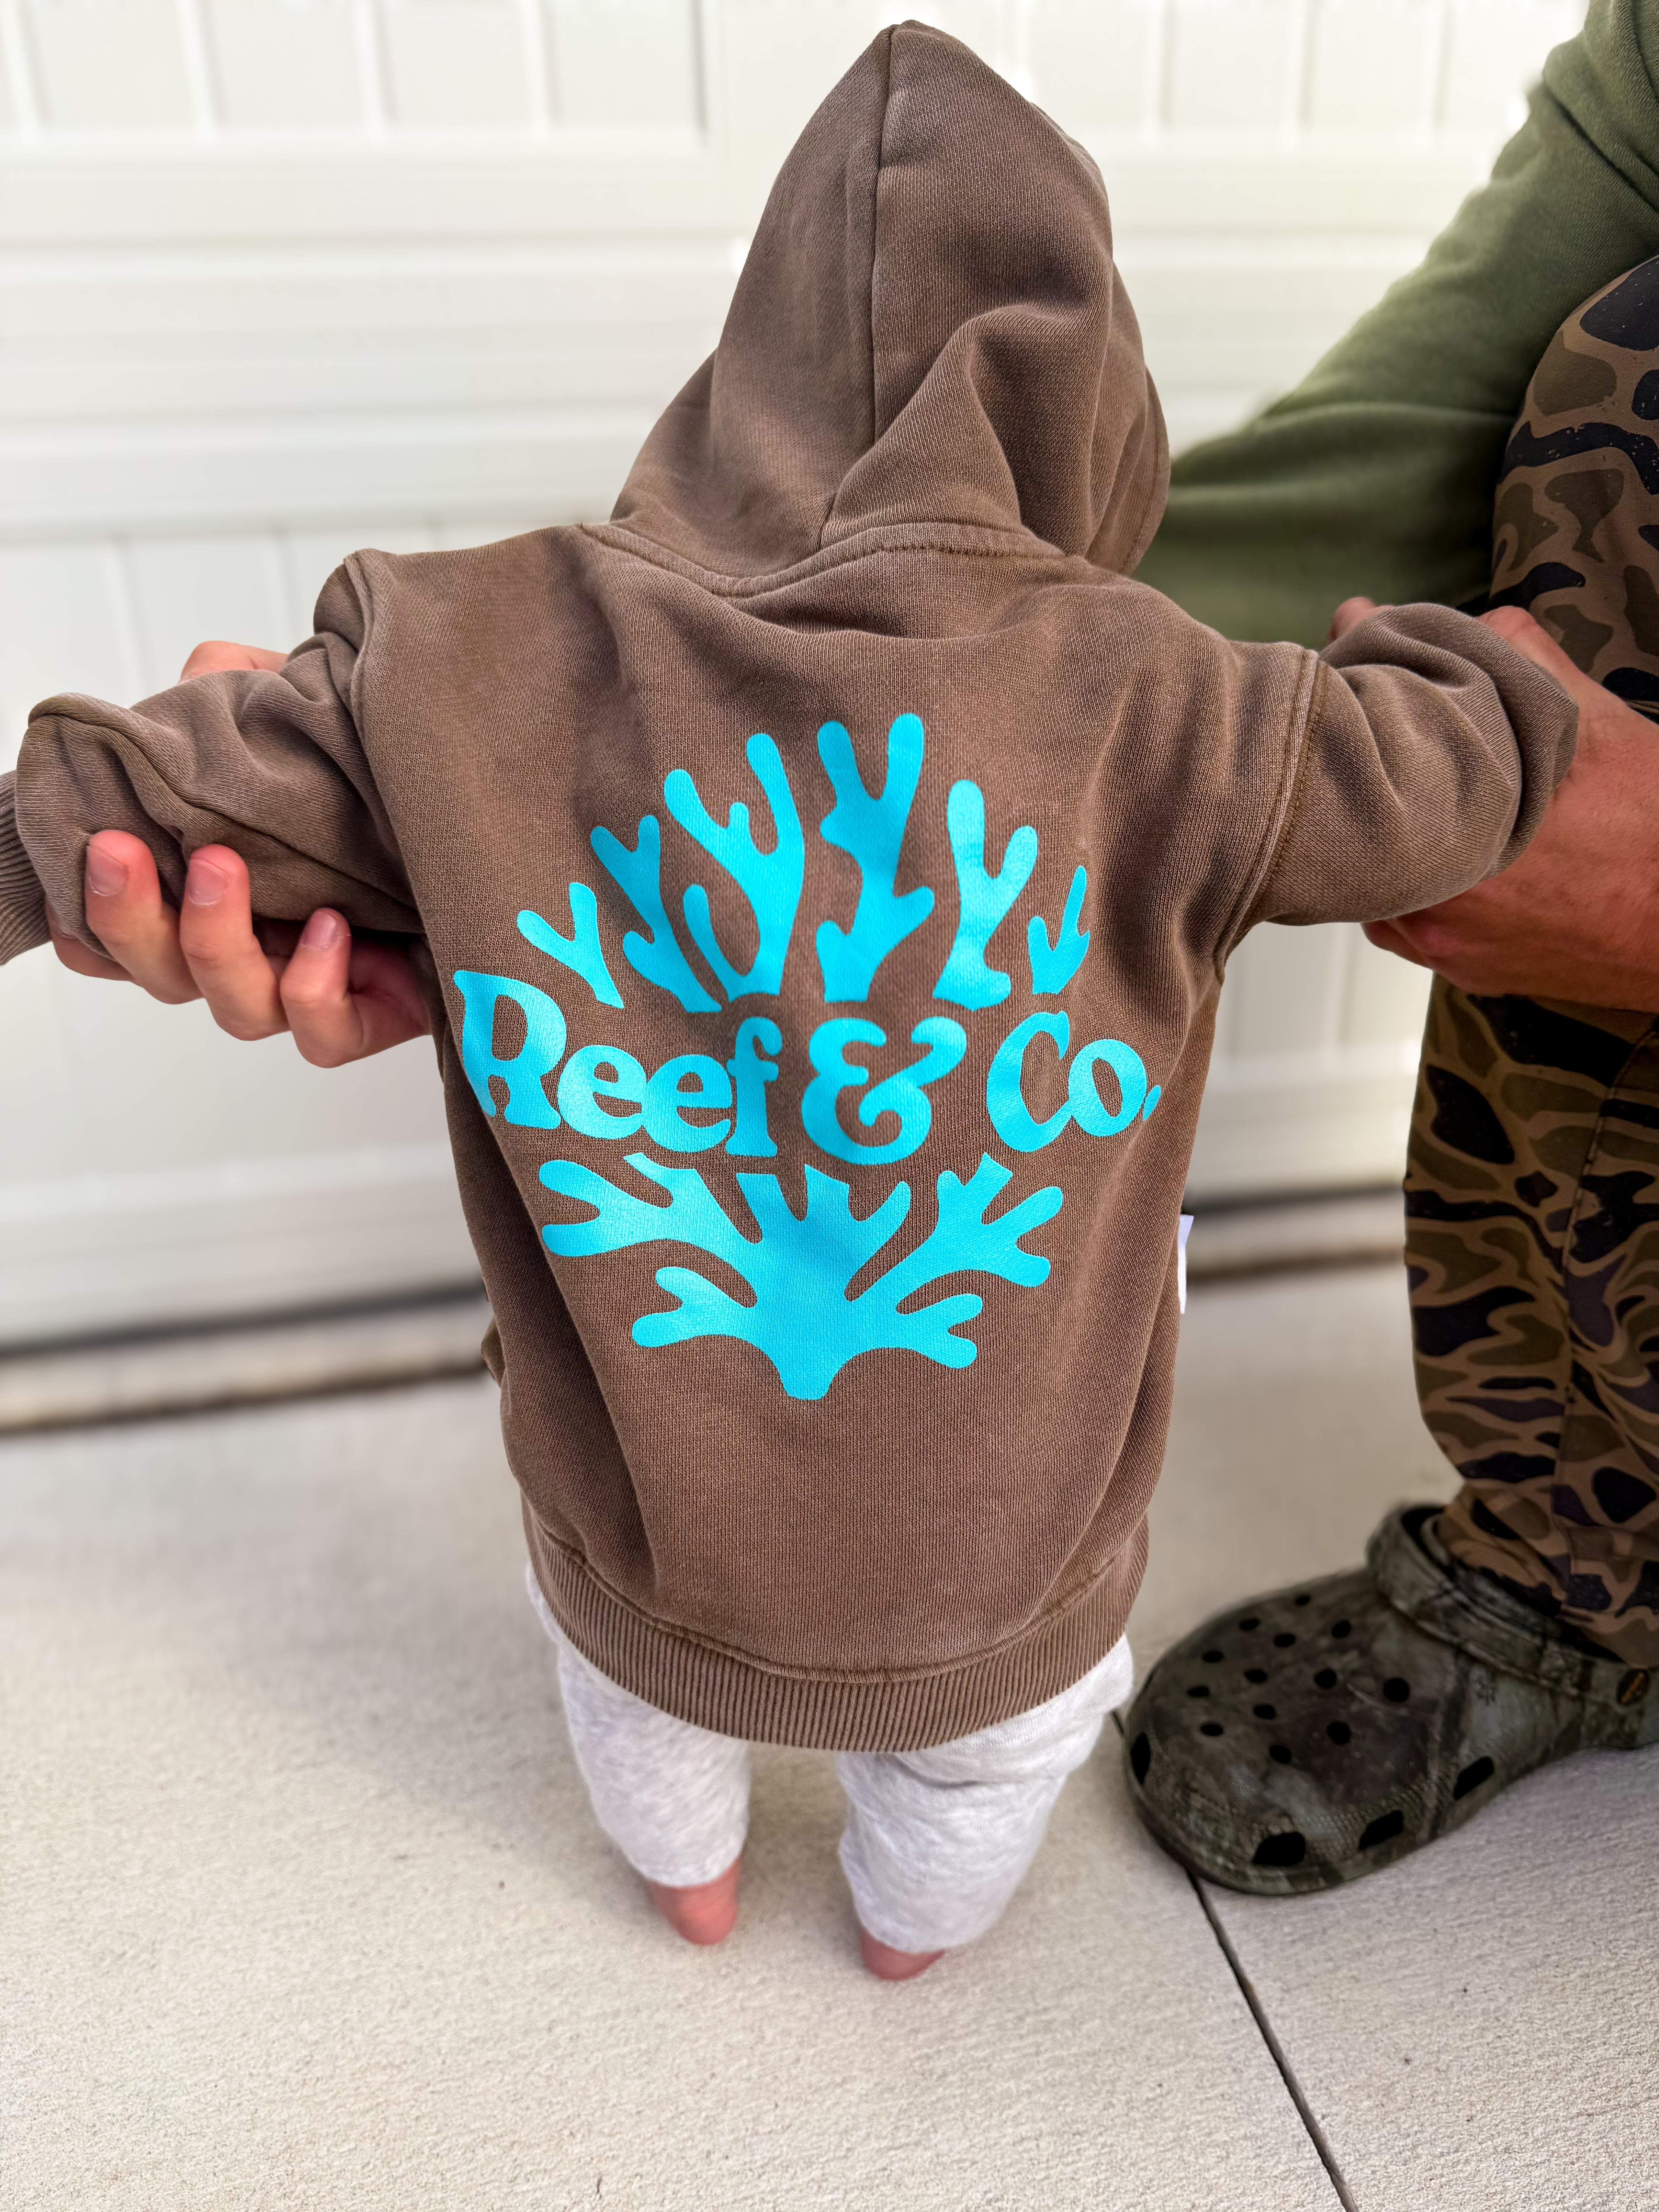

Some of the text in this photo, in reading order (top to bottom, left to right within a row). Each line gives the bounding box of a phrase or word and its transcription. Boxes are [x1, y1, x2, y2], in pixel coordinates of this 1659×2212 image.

[453, 970, 1160, 1165] Reef & Co.
